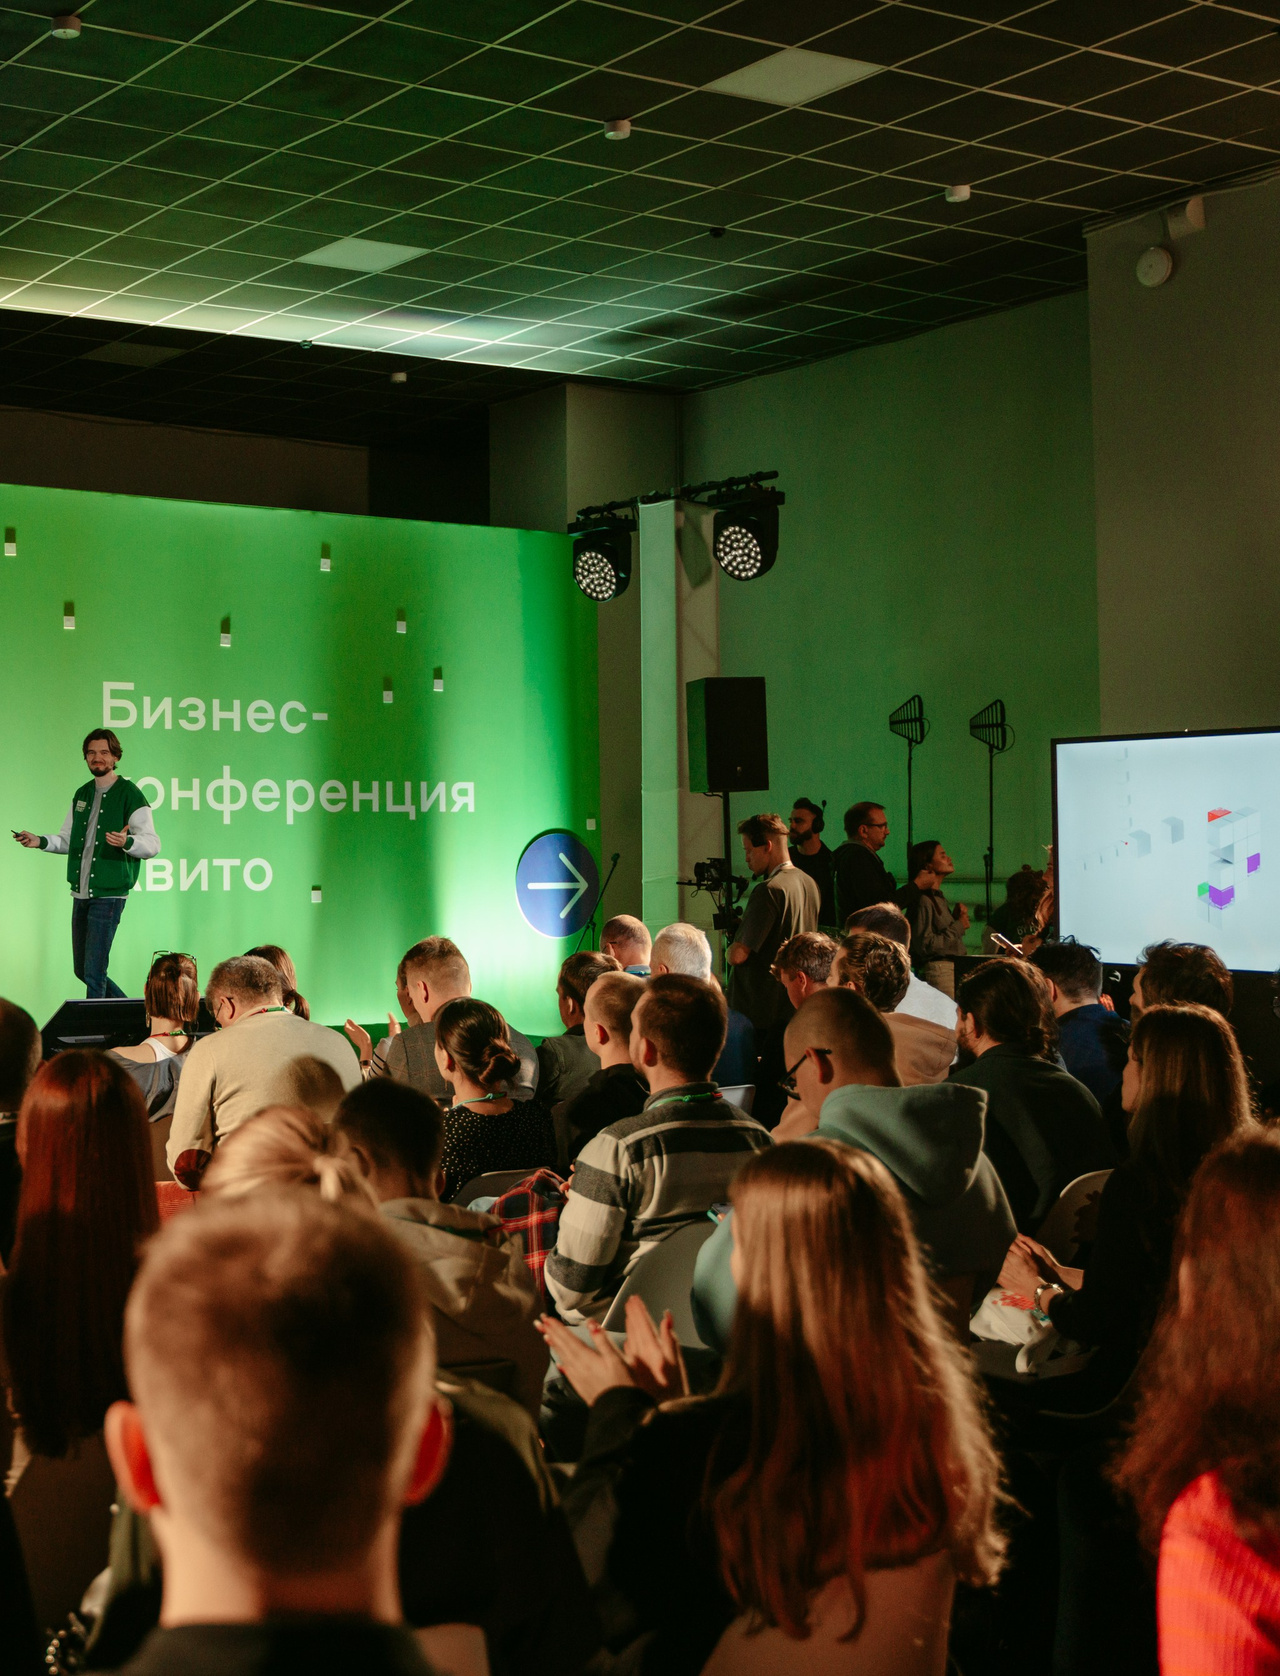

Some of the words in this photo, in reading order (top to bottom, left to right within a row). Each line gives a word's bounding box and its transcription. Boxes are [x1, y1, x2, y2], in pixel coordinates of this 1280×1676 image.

[102, 681, 329, 734] Бизнес-
[125, 765, 476, 825] онференция
[133, 857, 274, 893] вито
